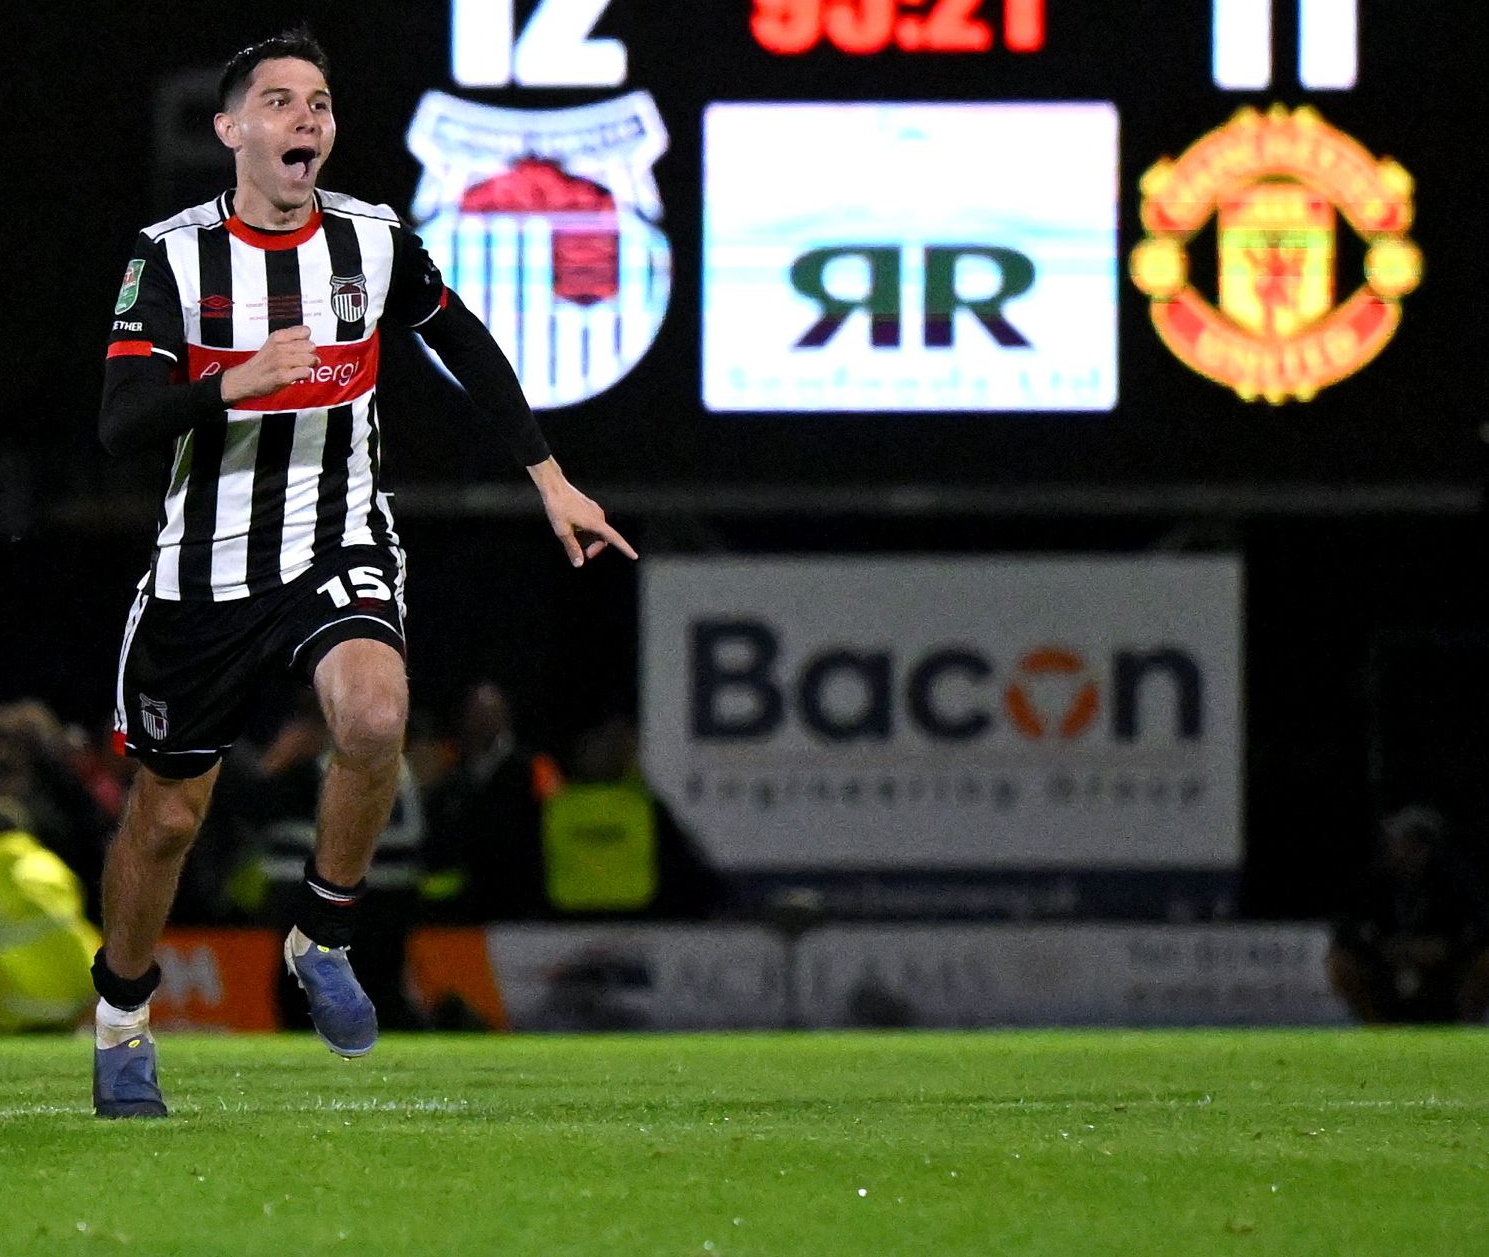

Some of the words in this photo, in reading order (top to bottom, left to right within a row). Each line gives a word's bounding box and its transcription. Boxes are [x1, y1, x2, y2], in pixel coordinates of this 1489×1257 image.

[111, 320, 143, 332] ETHER
[301, 357, 360, 387] nergi
[316, 566, 392, 609] 15
[689, 619, 1203, 742] Bacon
